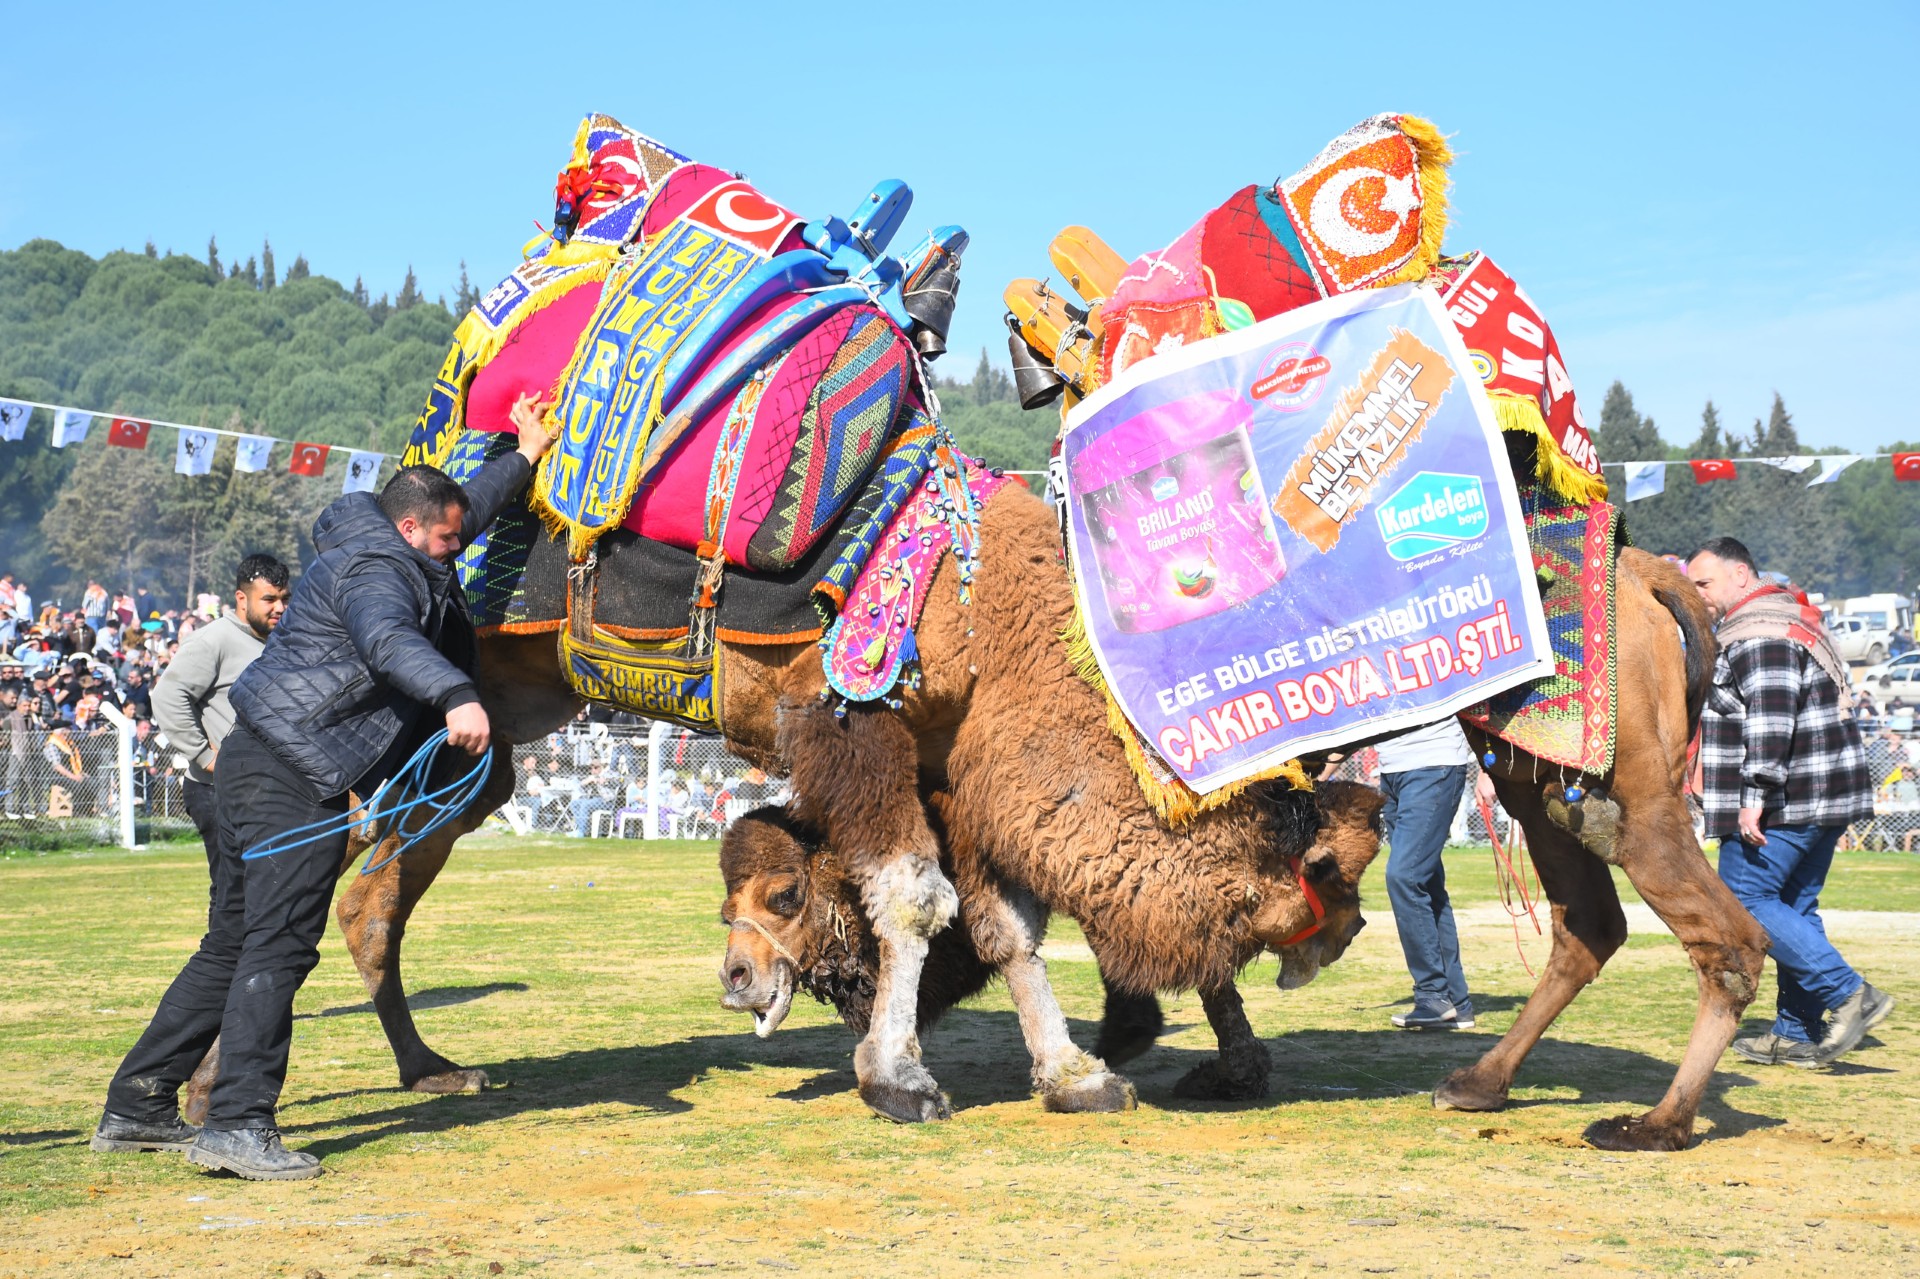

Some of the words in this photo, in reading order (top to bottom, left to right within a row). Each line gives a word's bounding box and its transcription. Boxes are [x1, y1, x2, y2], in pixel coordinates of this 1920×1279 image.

[559, 230, 713, 501] ZUMRUT
[586, 248, 748, 517] KUYUMCULUK
[1298, 357, 1424, 506] MÜKEMMEL
[1318, 385, 1429, 523] BEYAZLIK
[1137, 490, 1215, 537] BRİLAND
[1146, 534, 1179, 553] Tavan
[1381, 486, 1481, 535] Kardelen
[1457, 510, 1485, 526] boya
[599, 662, 685, 698] ZUMRUT
[1155, 673, 1214, 716] EGE
[1213, 640, 1305, 692] BÖLGE
[1305, 574, 1493, 663] DİSTRİBÜTÖRÜ
[573, 671, 712, 719] KUYUMCULUK
[1159, 690, 1282, 773] ÇAKIR
[1277, 657, 1387, 723] BOYA
